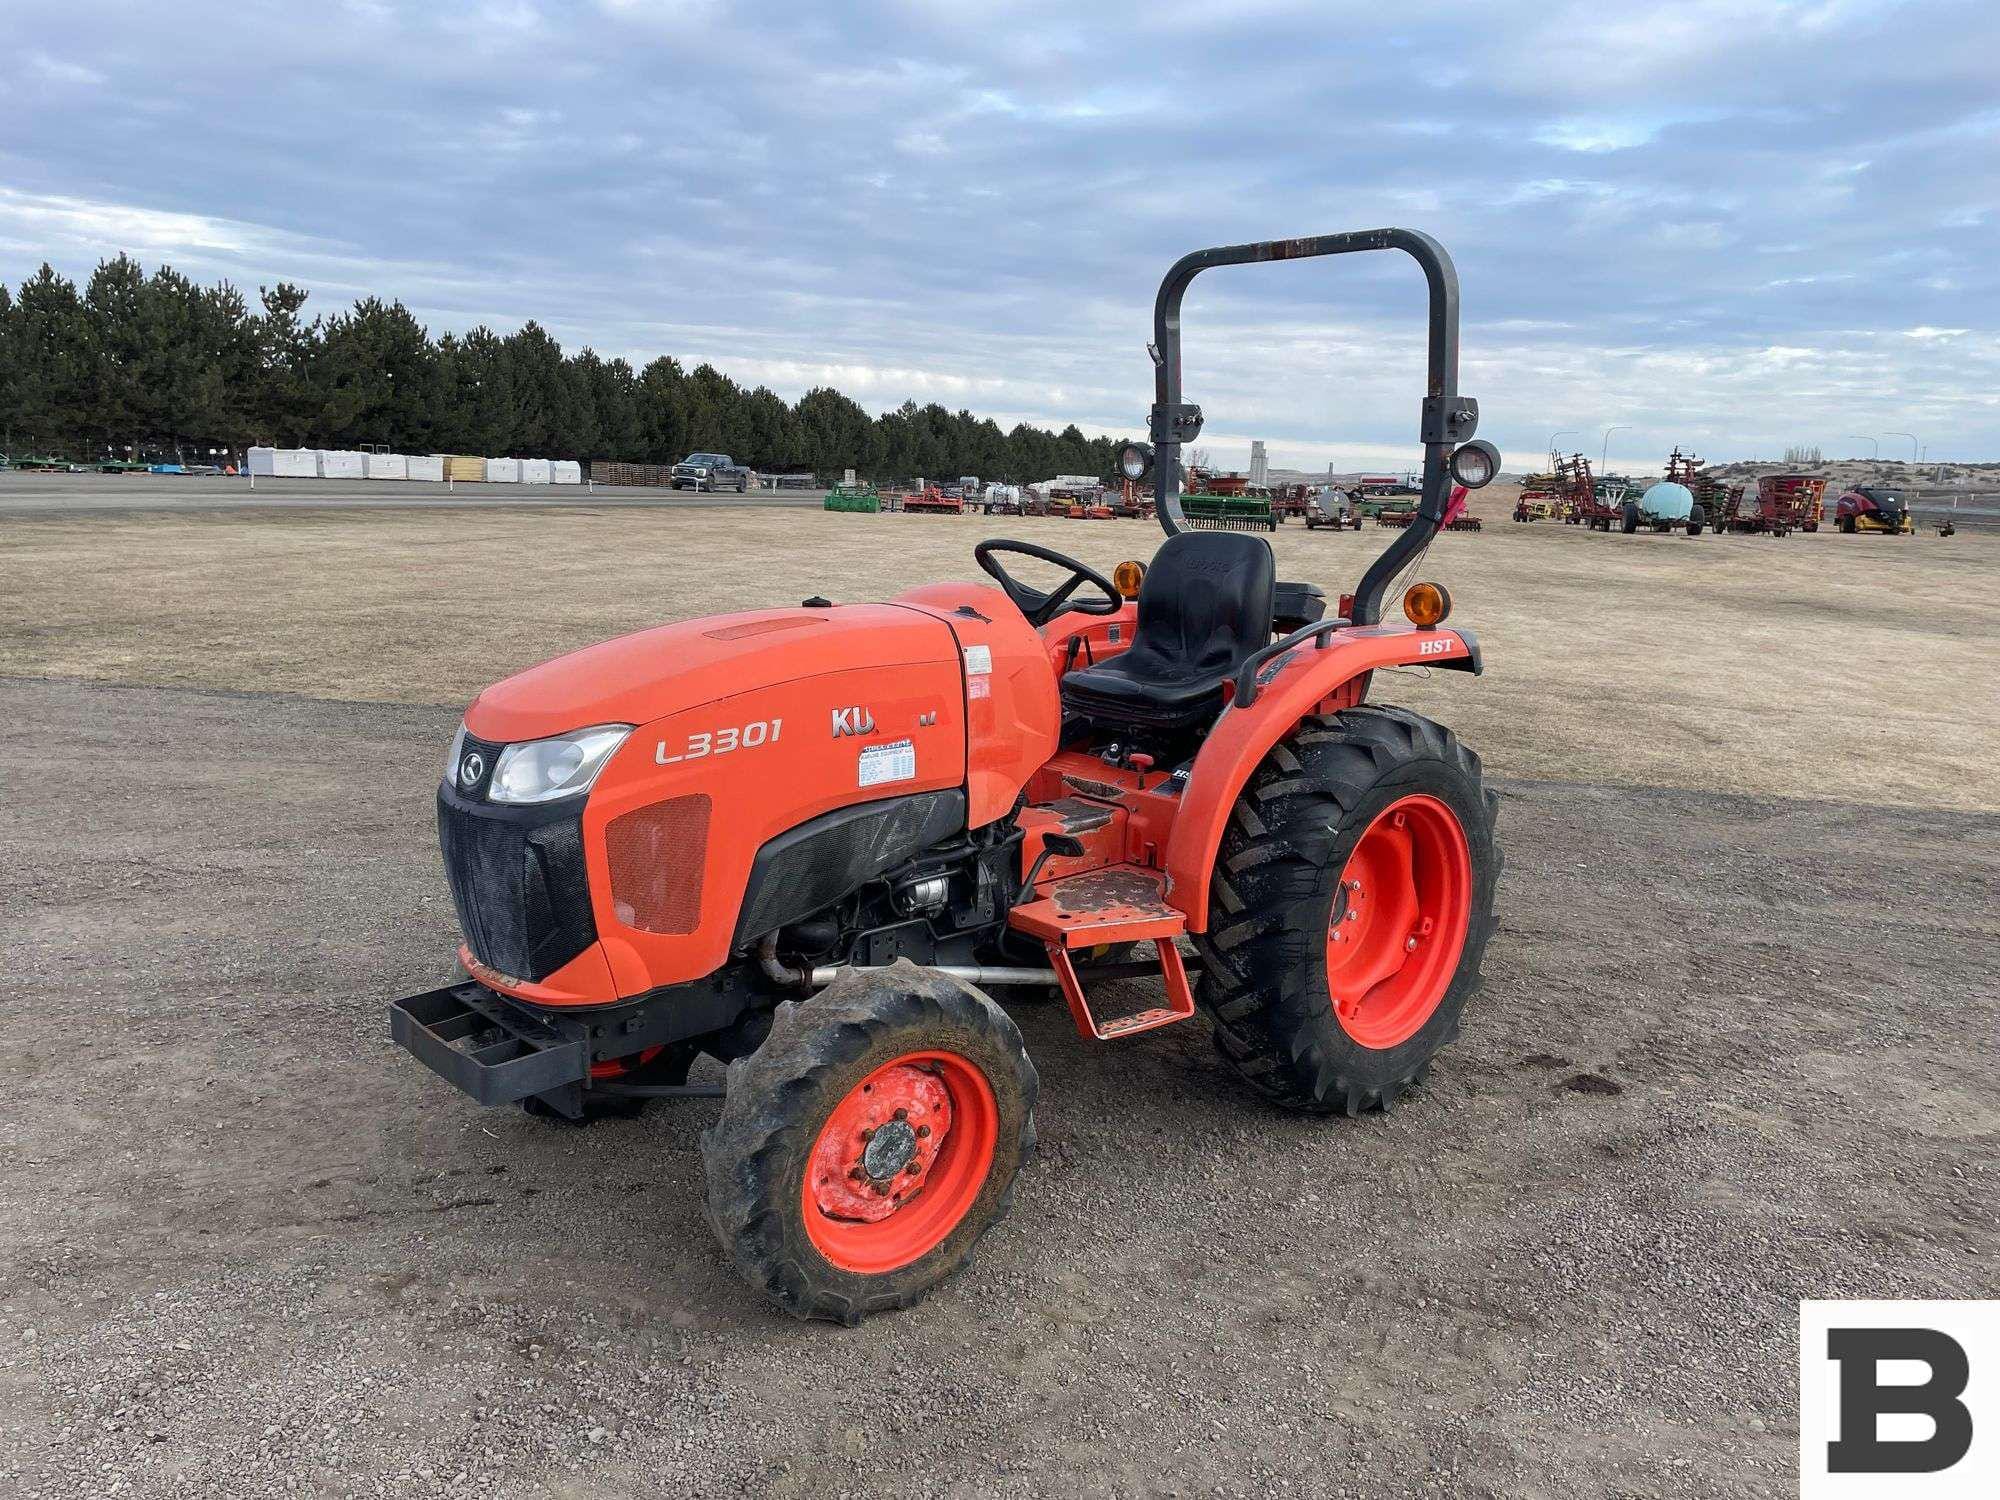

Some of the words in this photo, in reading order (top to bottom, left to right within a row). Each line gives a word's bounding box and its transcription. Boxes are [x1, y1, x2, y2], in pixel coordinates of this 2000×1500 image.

[1420, 639, 1454, 655] HST
[655, 719, 782, 765] L3301
[1173, 769, 1190, 779] HS
